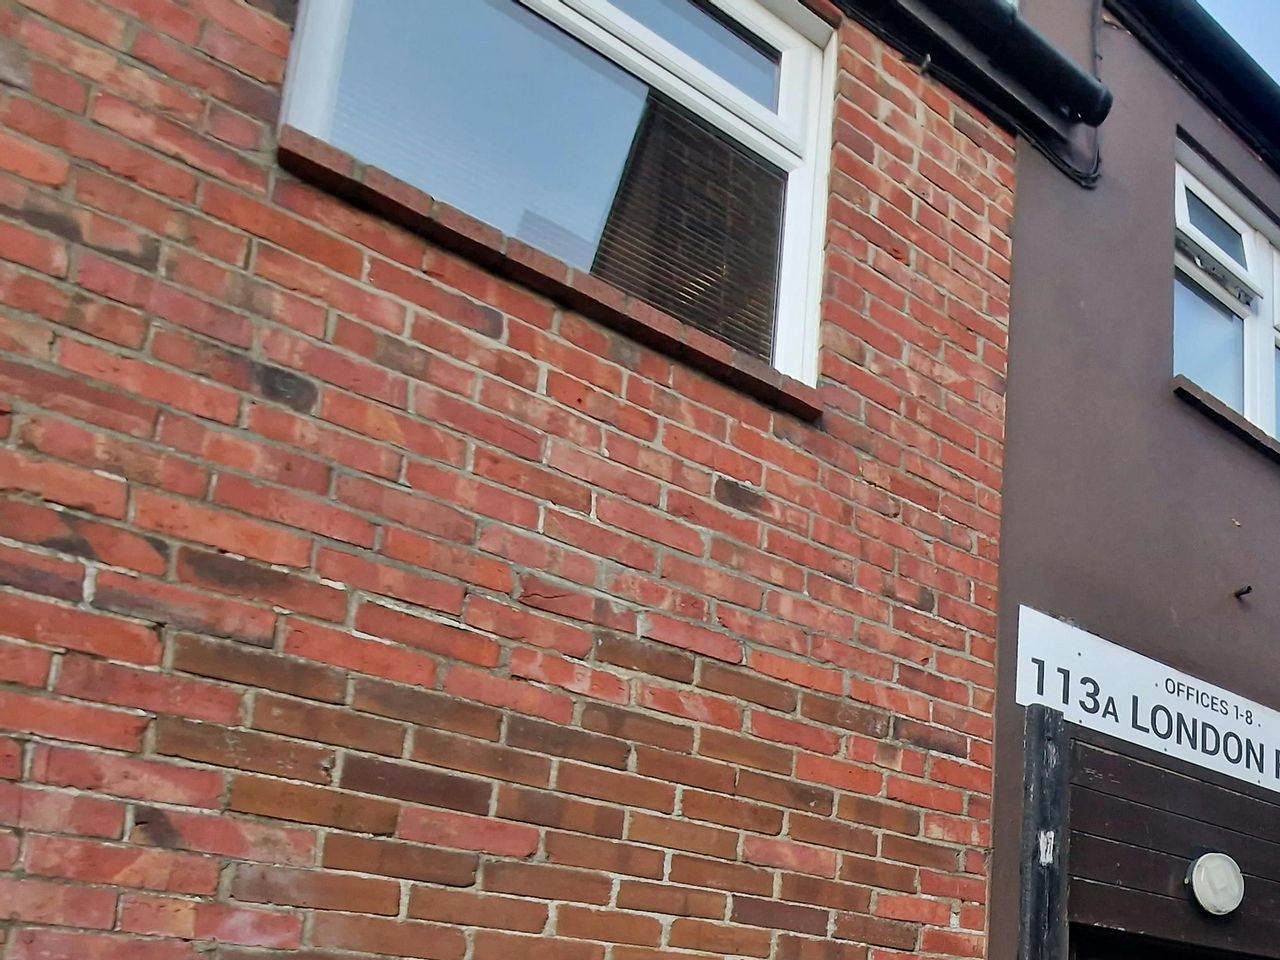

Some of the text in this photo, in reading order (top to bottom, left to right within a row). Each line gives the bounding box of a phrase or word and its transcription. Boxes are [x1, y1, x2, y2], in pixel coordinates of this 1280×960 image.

[1031, 657, 1120, 723] 113A
[1131, 695, 1265, 774] LONDON
[1165, 677, 1254, 725] OFFICES 1-8
